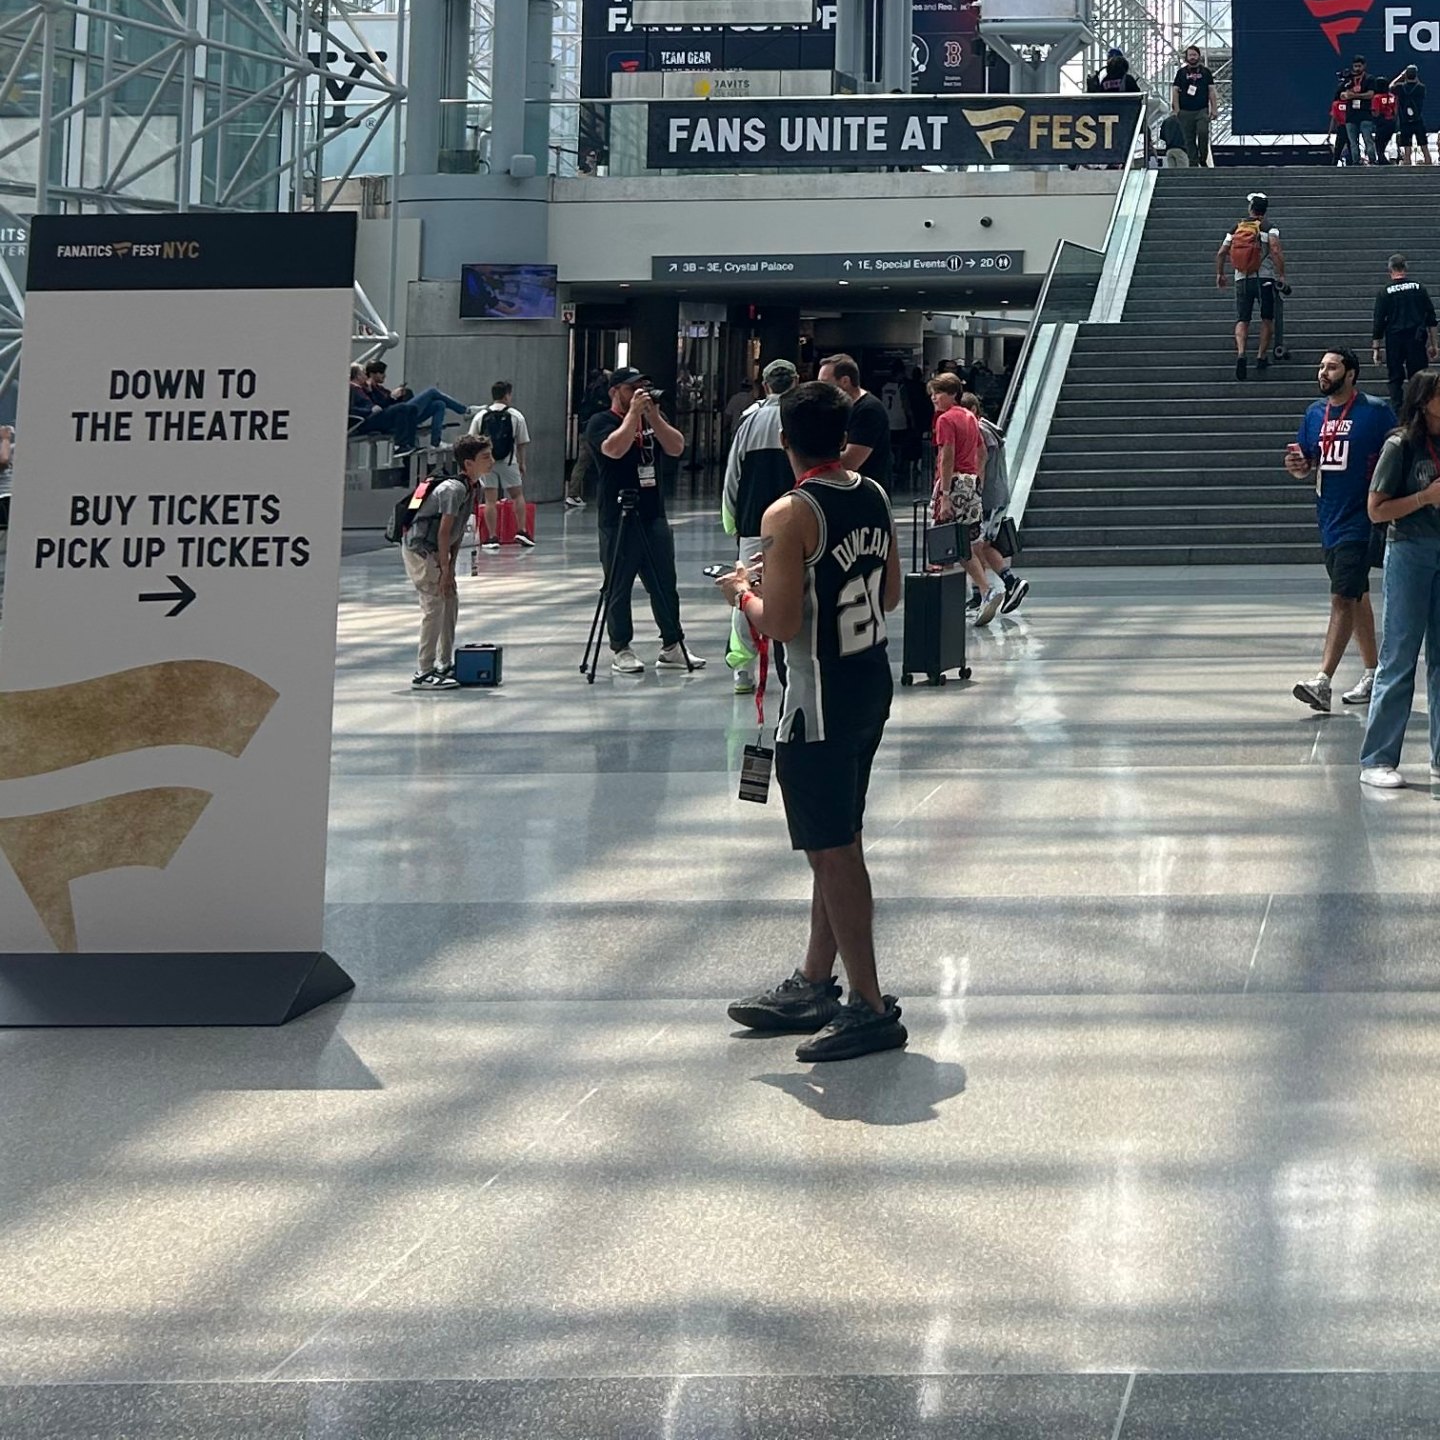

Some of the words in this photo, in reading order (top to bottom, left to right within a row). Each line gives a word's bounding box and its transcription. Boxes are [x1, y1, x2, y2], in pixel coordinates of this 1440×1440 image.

[661, 52, 686, 64] TEAM
[688, 51, 711, 64] GEAR
[714, 80, 750, 88] JAVITS
[668, 116, 766, 153] FANS
[779, 116, 888, 152] UNITE
[900, 115, 949, 151] AT
[1028, 114, 1120, 150] FEST
[57, 244, 113, 258] FANATICS
[132, 244, 162, 257] FEST
[162, 241, 200, 259] NYC
[682, 262, 696, 272] 3B
[706, 262, 723, 273] 3E,
[724, 261, 758, 274] Crystal
[760, 261, 794, 271] Palace
[857, 260, 873, 271] 1E,
[874, 260, 911, 272] Special
[912, 259, 946, 269] Events
[980, 258, 994, 268] 2D
[1386, 282, 1420, 294] SECURITY
[109, 369, 205, 400] DOWN
[216, 368, 257, 400] TO
[71, 411, 132, 442] THE
[144, 410, 290, 442] THEATRE
[69, 495, 137, 527] BUY
[147, 494, 281, 526] TICKETS
[35, 538, 110, 569] PICK
[122, 536, 166, 568] UP
[176, 535, 311, 568] TICKETS
[831, 526, 890, 573] DUNCAN
[837, 565, 887, 657] 21
